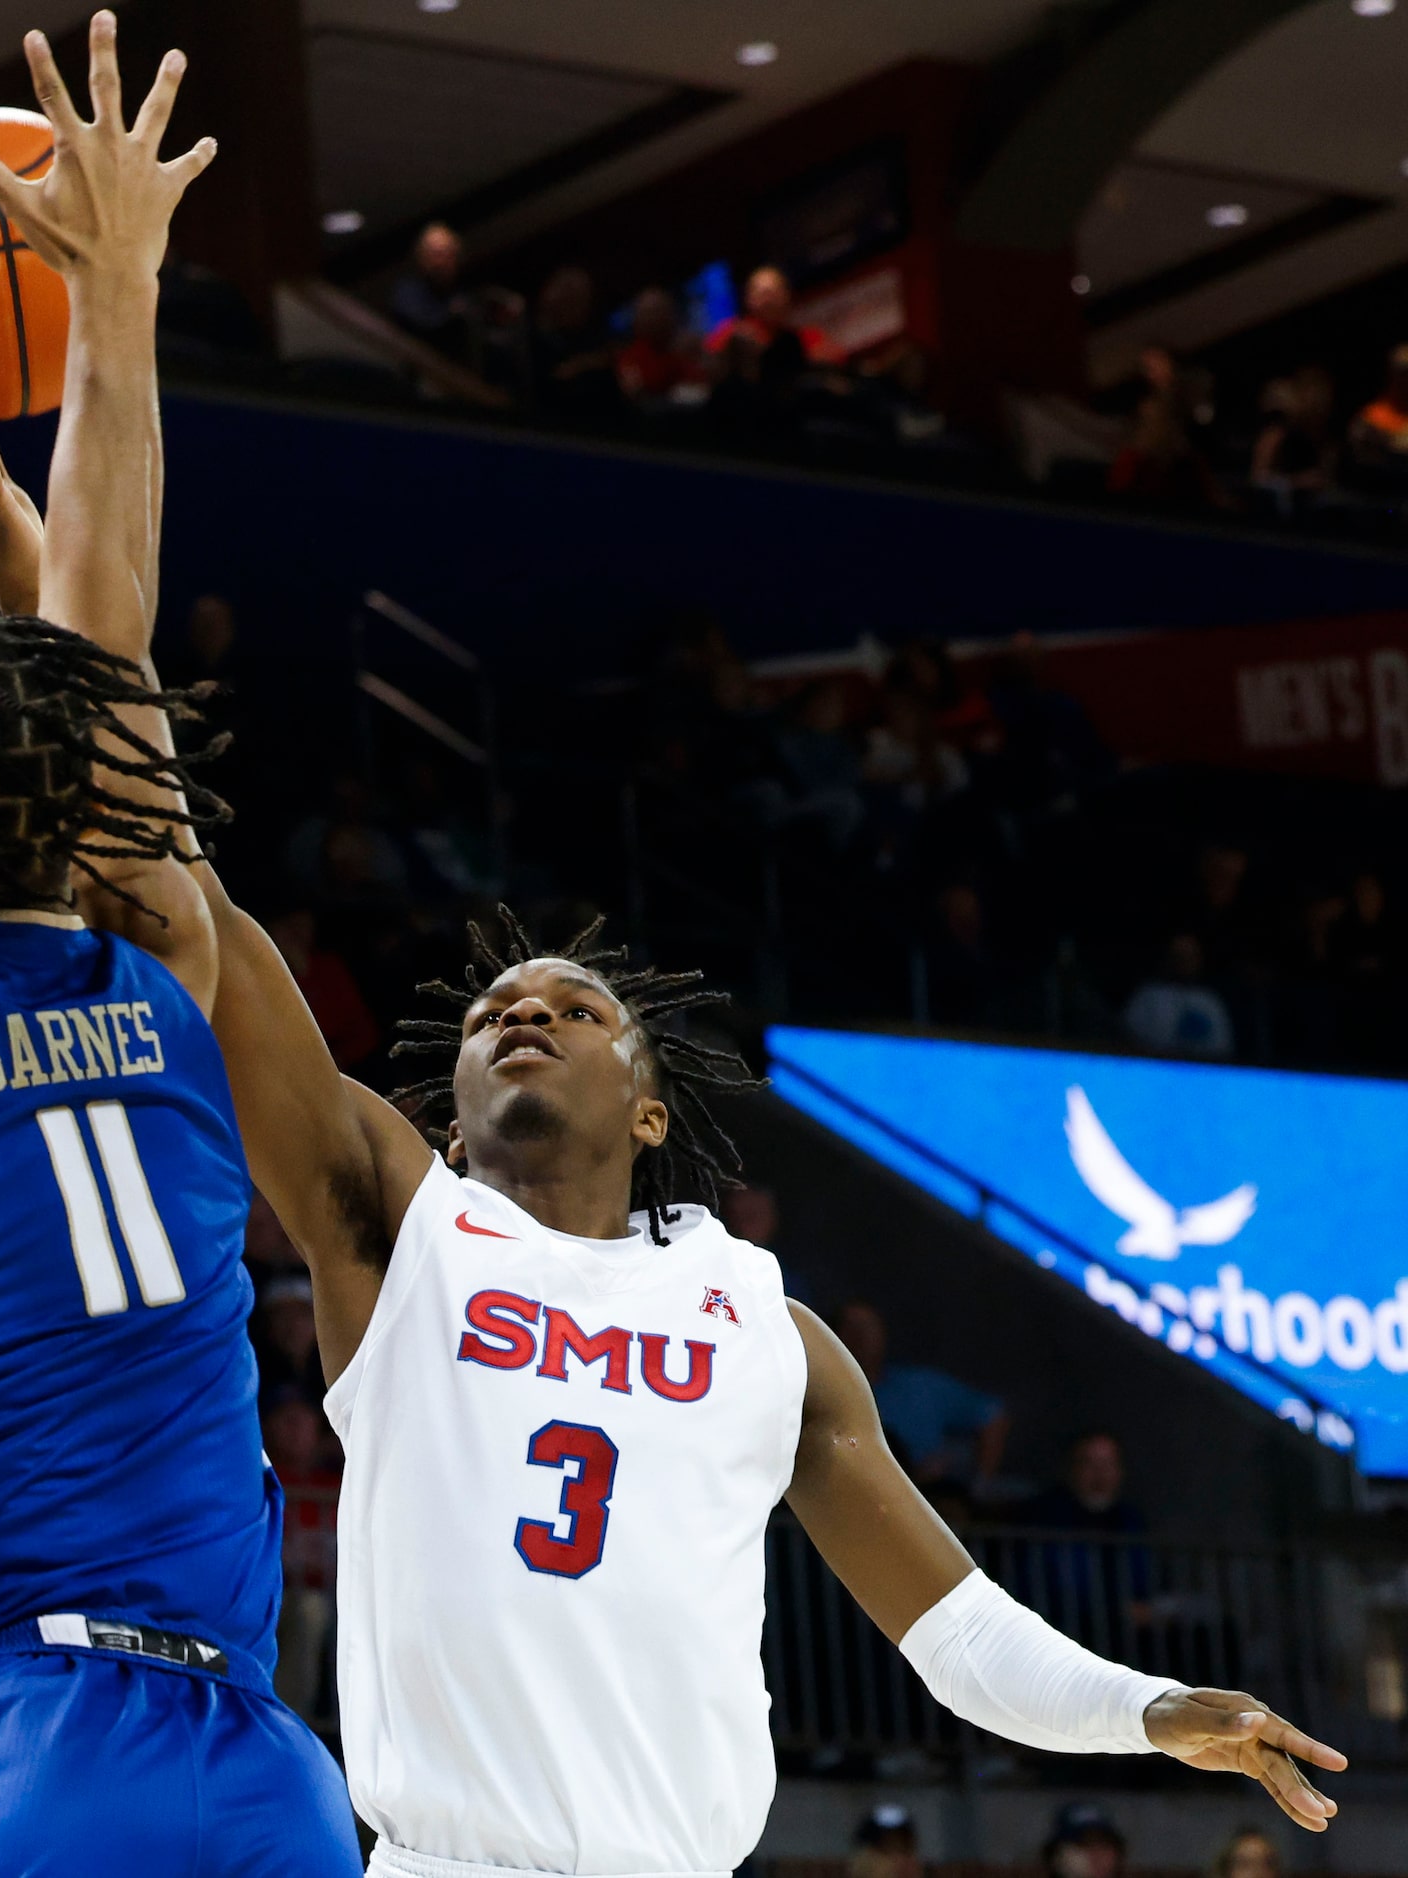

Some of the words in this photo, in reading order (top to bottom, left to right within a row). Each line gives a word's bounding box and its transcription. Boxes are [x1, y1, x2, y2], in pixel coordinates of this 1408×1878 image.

[1234, 657, 1367, 751] MEN'S
[35, 1098, 187, 1318] 11
[457, 1288, 717, 1403] SMU
[514, 1418, 619, 1580] 3
